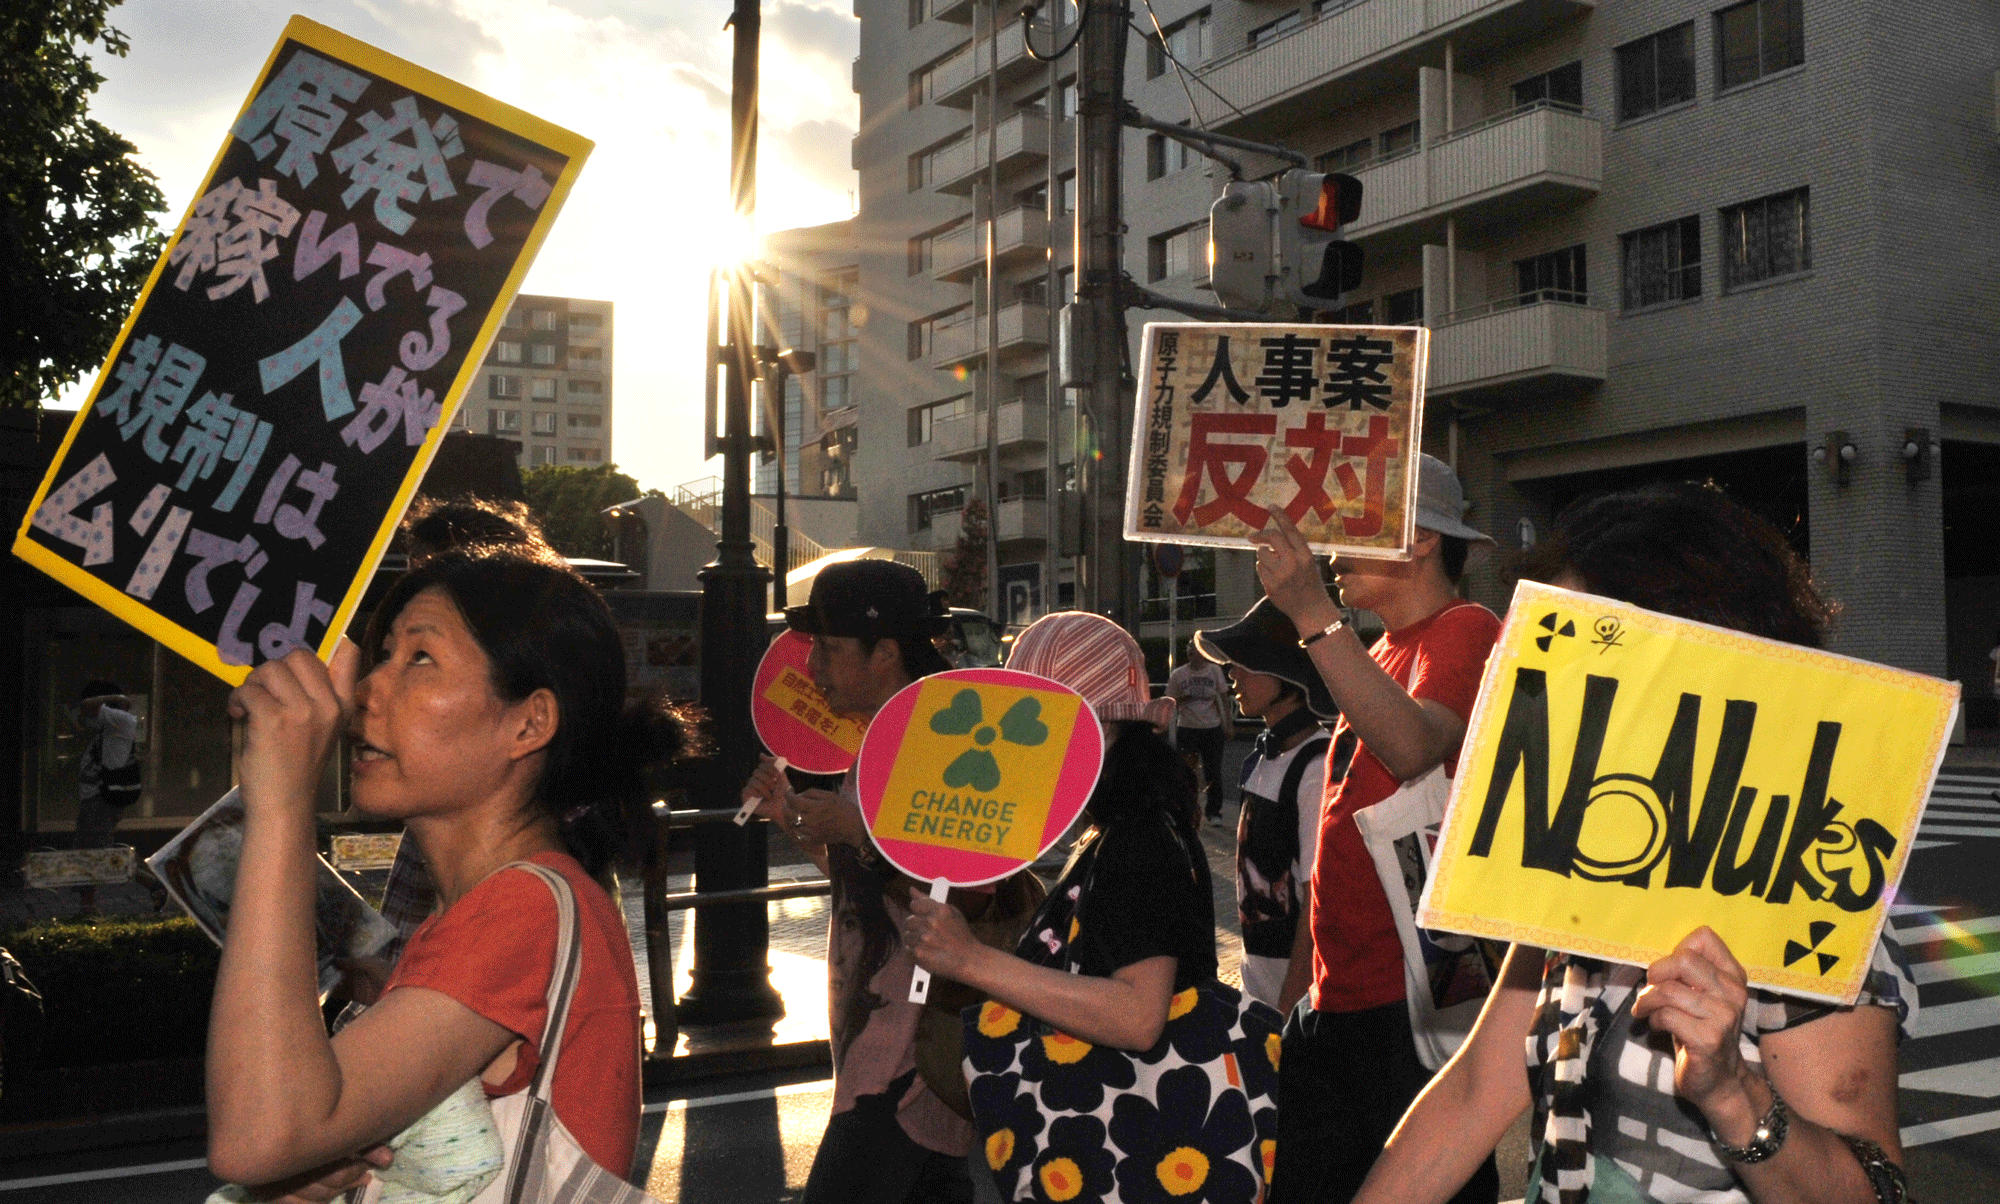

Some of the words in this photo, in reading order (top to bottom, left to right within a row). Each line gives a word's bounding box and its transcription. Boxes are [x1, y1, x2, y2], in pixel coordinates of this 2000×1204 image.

[230, 49, 551, 249] 原発で
[168, 177, 466, 371] 稼いでる
[97, 333, 340, 550] 規制は
[259, 296, 443, 454] 人が
[1143, 331, 1179, 528] 原子力規制委員会
[1190, 334, 1393, 411] 人事案
[1172, 412, 1398, 537] 反対
[903, 812, 1010, 845] ENERGY
[911, 790, 1017, 823] CHANGE
